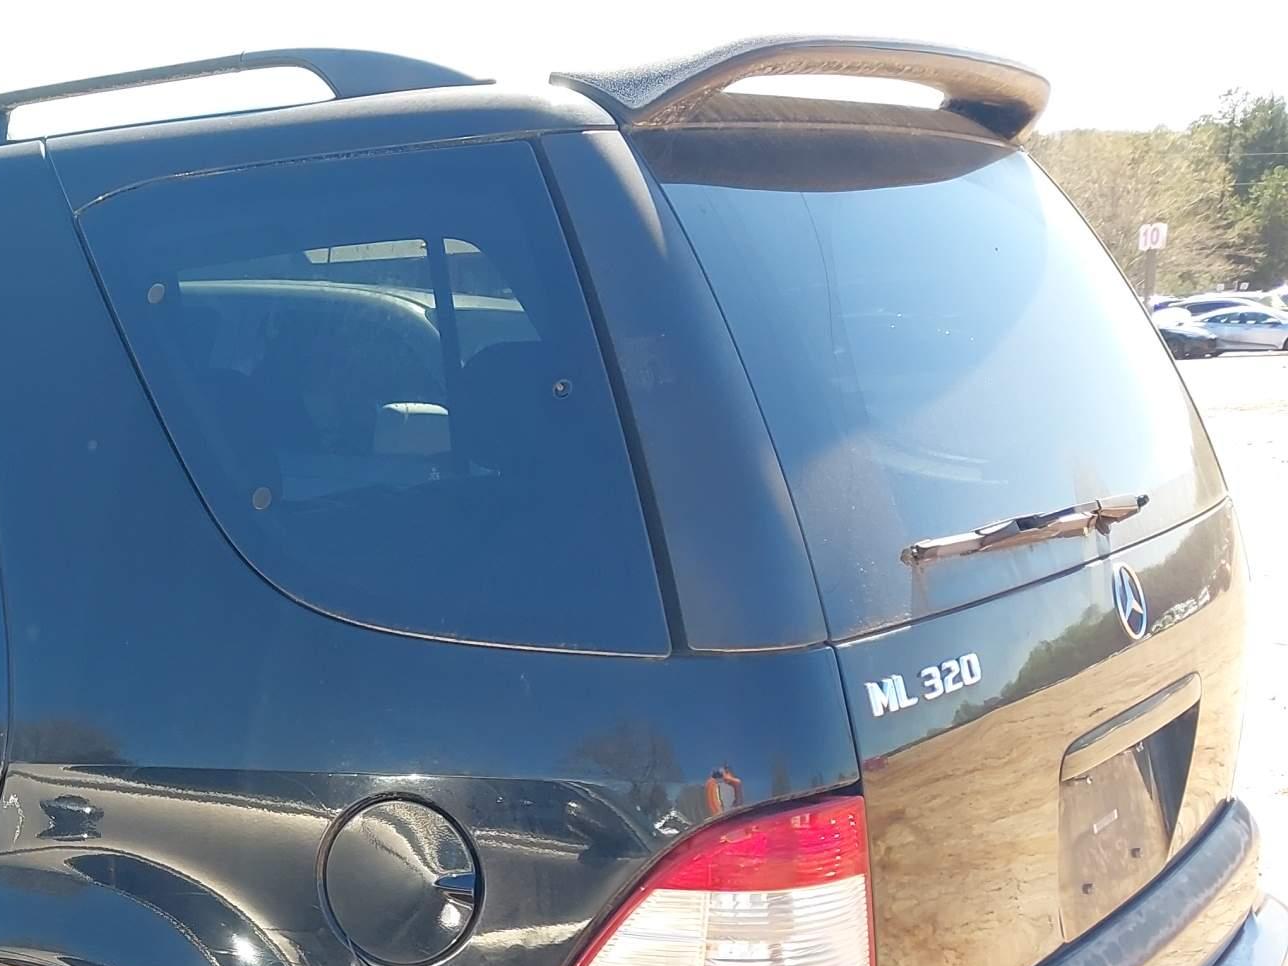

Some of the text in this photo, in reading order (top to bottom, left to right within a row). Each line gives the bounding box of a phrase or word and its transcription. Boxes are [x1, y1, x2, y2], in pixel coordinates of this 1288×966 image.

[1142, 226, 1160, 247] 10
[864, 652, 982, 717] ML 320
